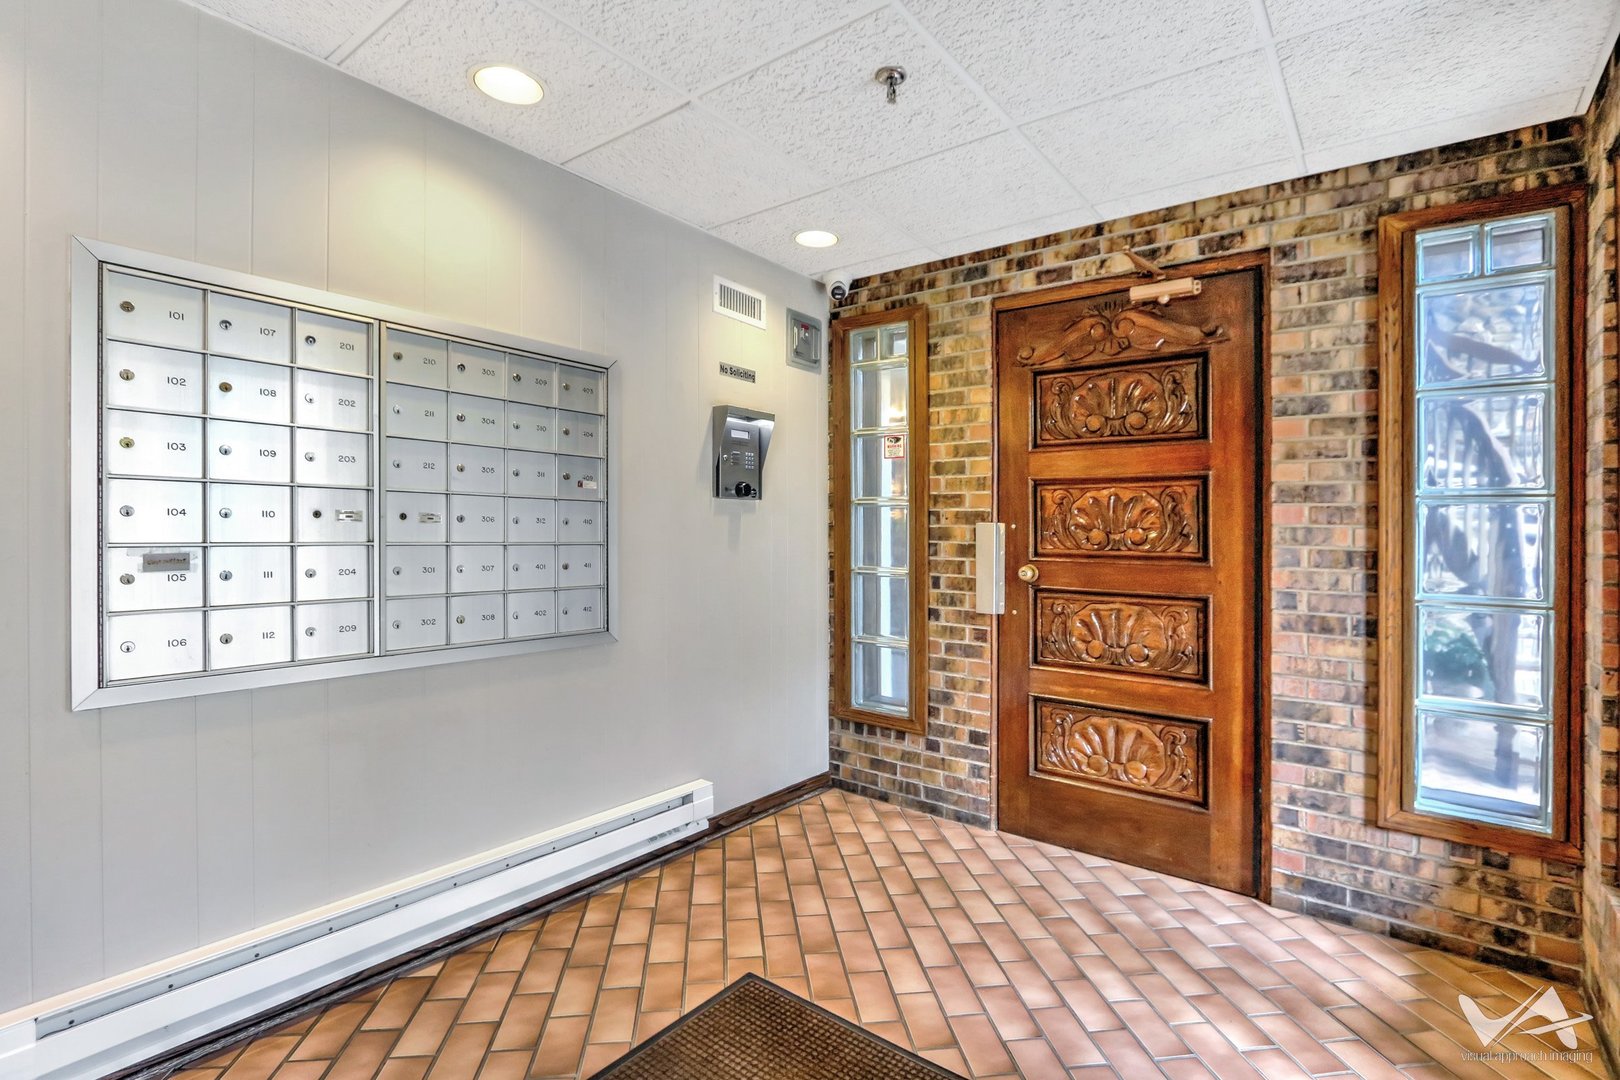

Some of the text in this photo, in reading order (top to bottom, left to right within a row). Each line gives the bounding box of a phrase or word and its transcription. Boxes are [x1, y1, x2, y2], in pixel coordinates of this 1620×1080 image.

[168, 310, 185, 321] 101
[259, 327, 277, 337] 107
[339, 341, 355, 352] 201
[422, 357, 437, 366] 210
[481, 368, 496, 377] 303
[720, 364, 755, 383] No Soliciting
[166, 376, 187, 387] 102
[534, 377, 548, 386] 309
[259, 387, 277, 398] 108
[338, 398, 357, 408] 202
[424, 409, 435, 418] 211
[481, 417, 496, 425] 304
[166, 442, 187, 452] 103
[259, 448, 277, 458] 109
[337, 454, 357, 464] 203
[422, 461, 436, 470] 212
[480, 466, 496, 474] 305
[166, 507, 187, 517] 104
[261, 510, 276, 519] 110
[481, 515, 496, 524] 306
[535, 517, 546, 525] 312
[338, 568, 357, 576] 204
[422, 566, 436, 574] 301
[481, 564, 495, 572] 307
[167, 573, 187, 582] 105
[263, 570, 273, 579] 111
[533, 609, 547, 617] 402
[582, 605, 593, 613] 412
[481, 613, 496, 621] 308
[420, 618, 437, 626] 302
[338, 624, 357, 633] 209
[262, 631, 276, 640] 112
[167, 638, 188, 648] 106
